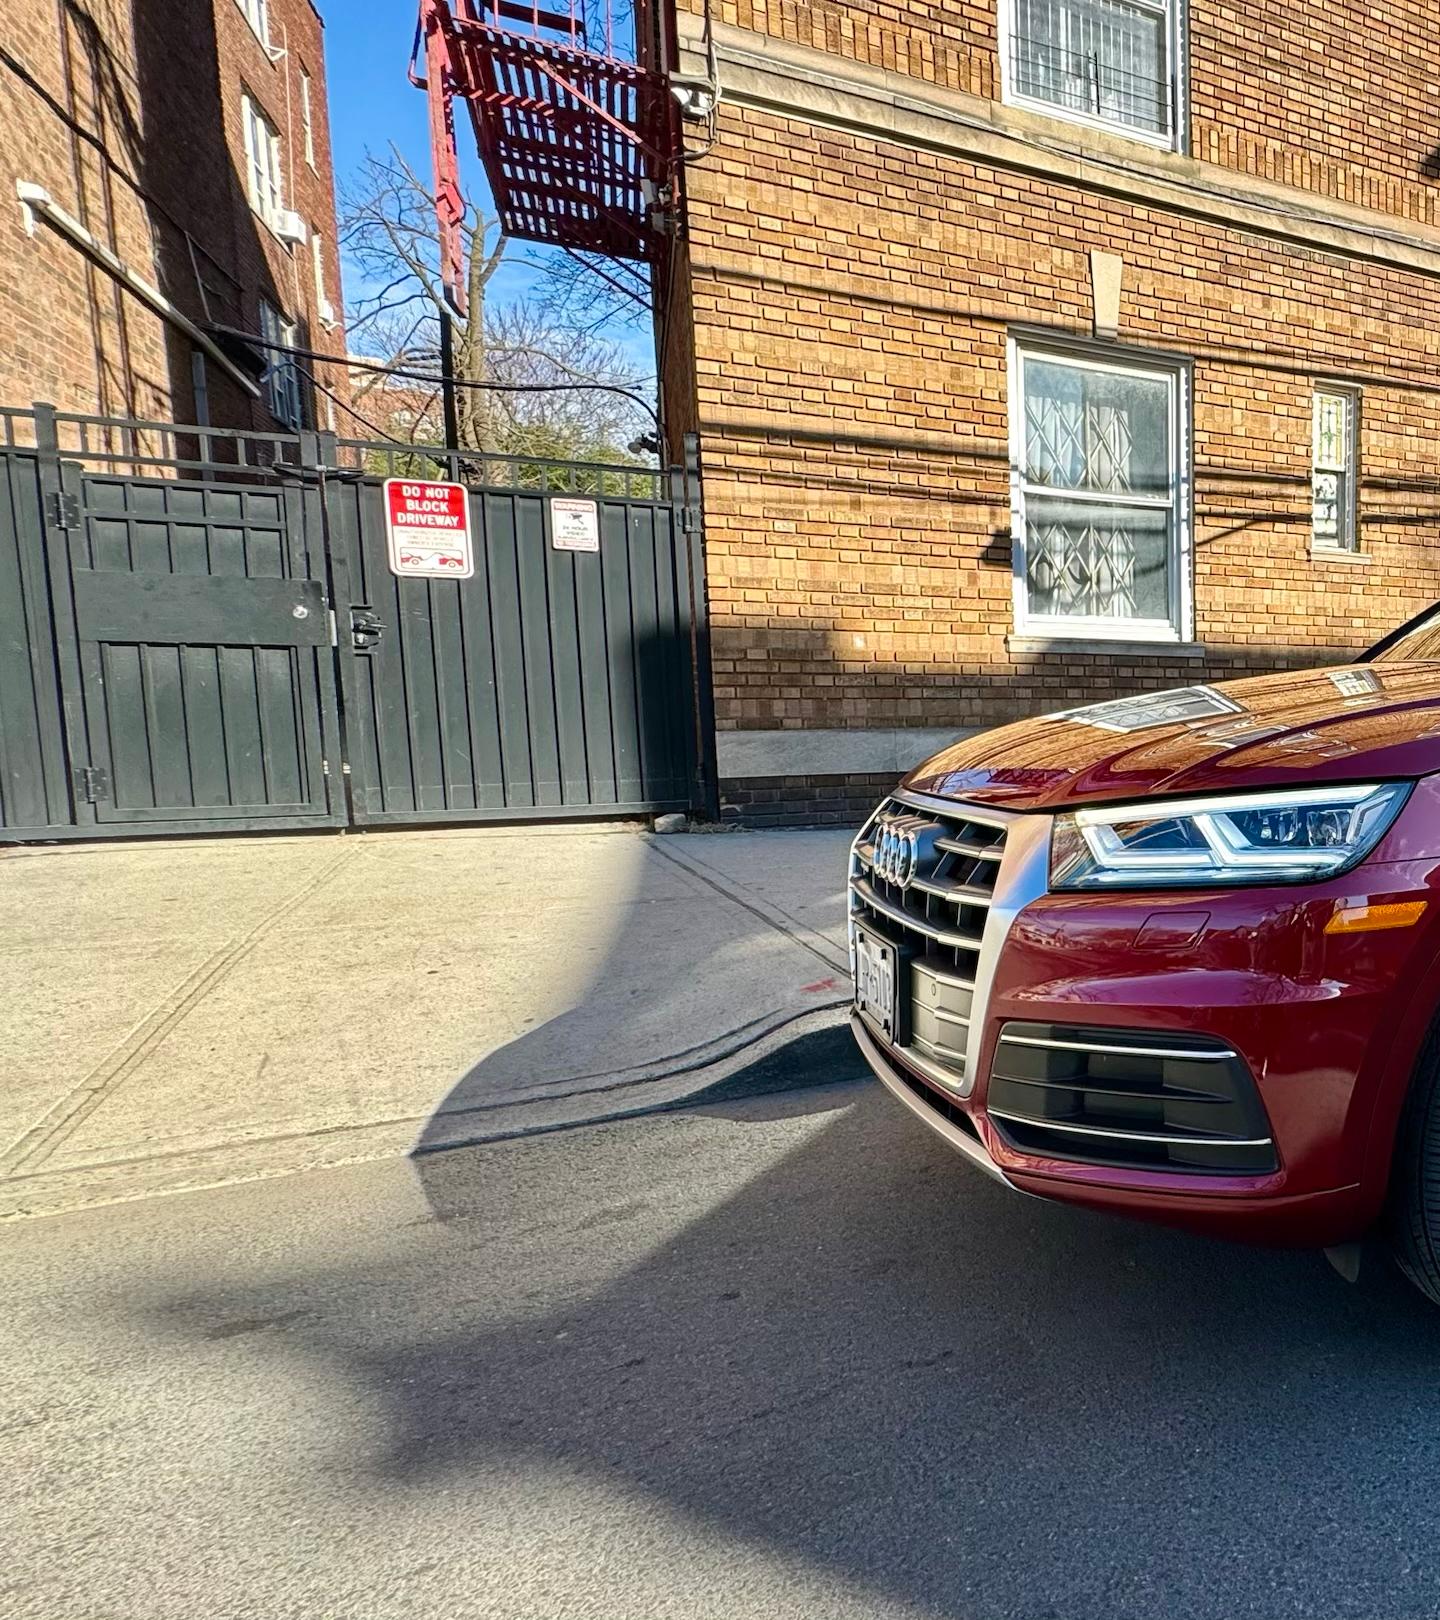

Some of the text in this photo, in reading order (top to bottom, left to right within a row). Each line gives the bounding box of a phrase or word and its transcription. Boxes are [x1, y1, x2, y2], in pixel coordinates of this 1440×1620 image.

[402, 485, 450, 500] DO NOT
[406, 498, 450, 513] BLOCK
[397, 511, 460, 527] DRIVEWAY
